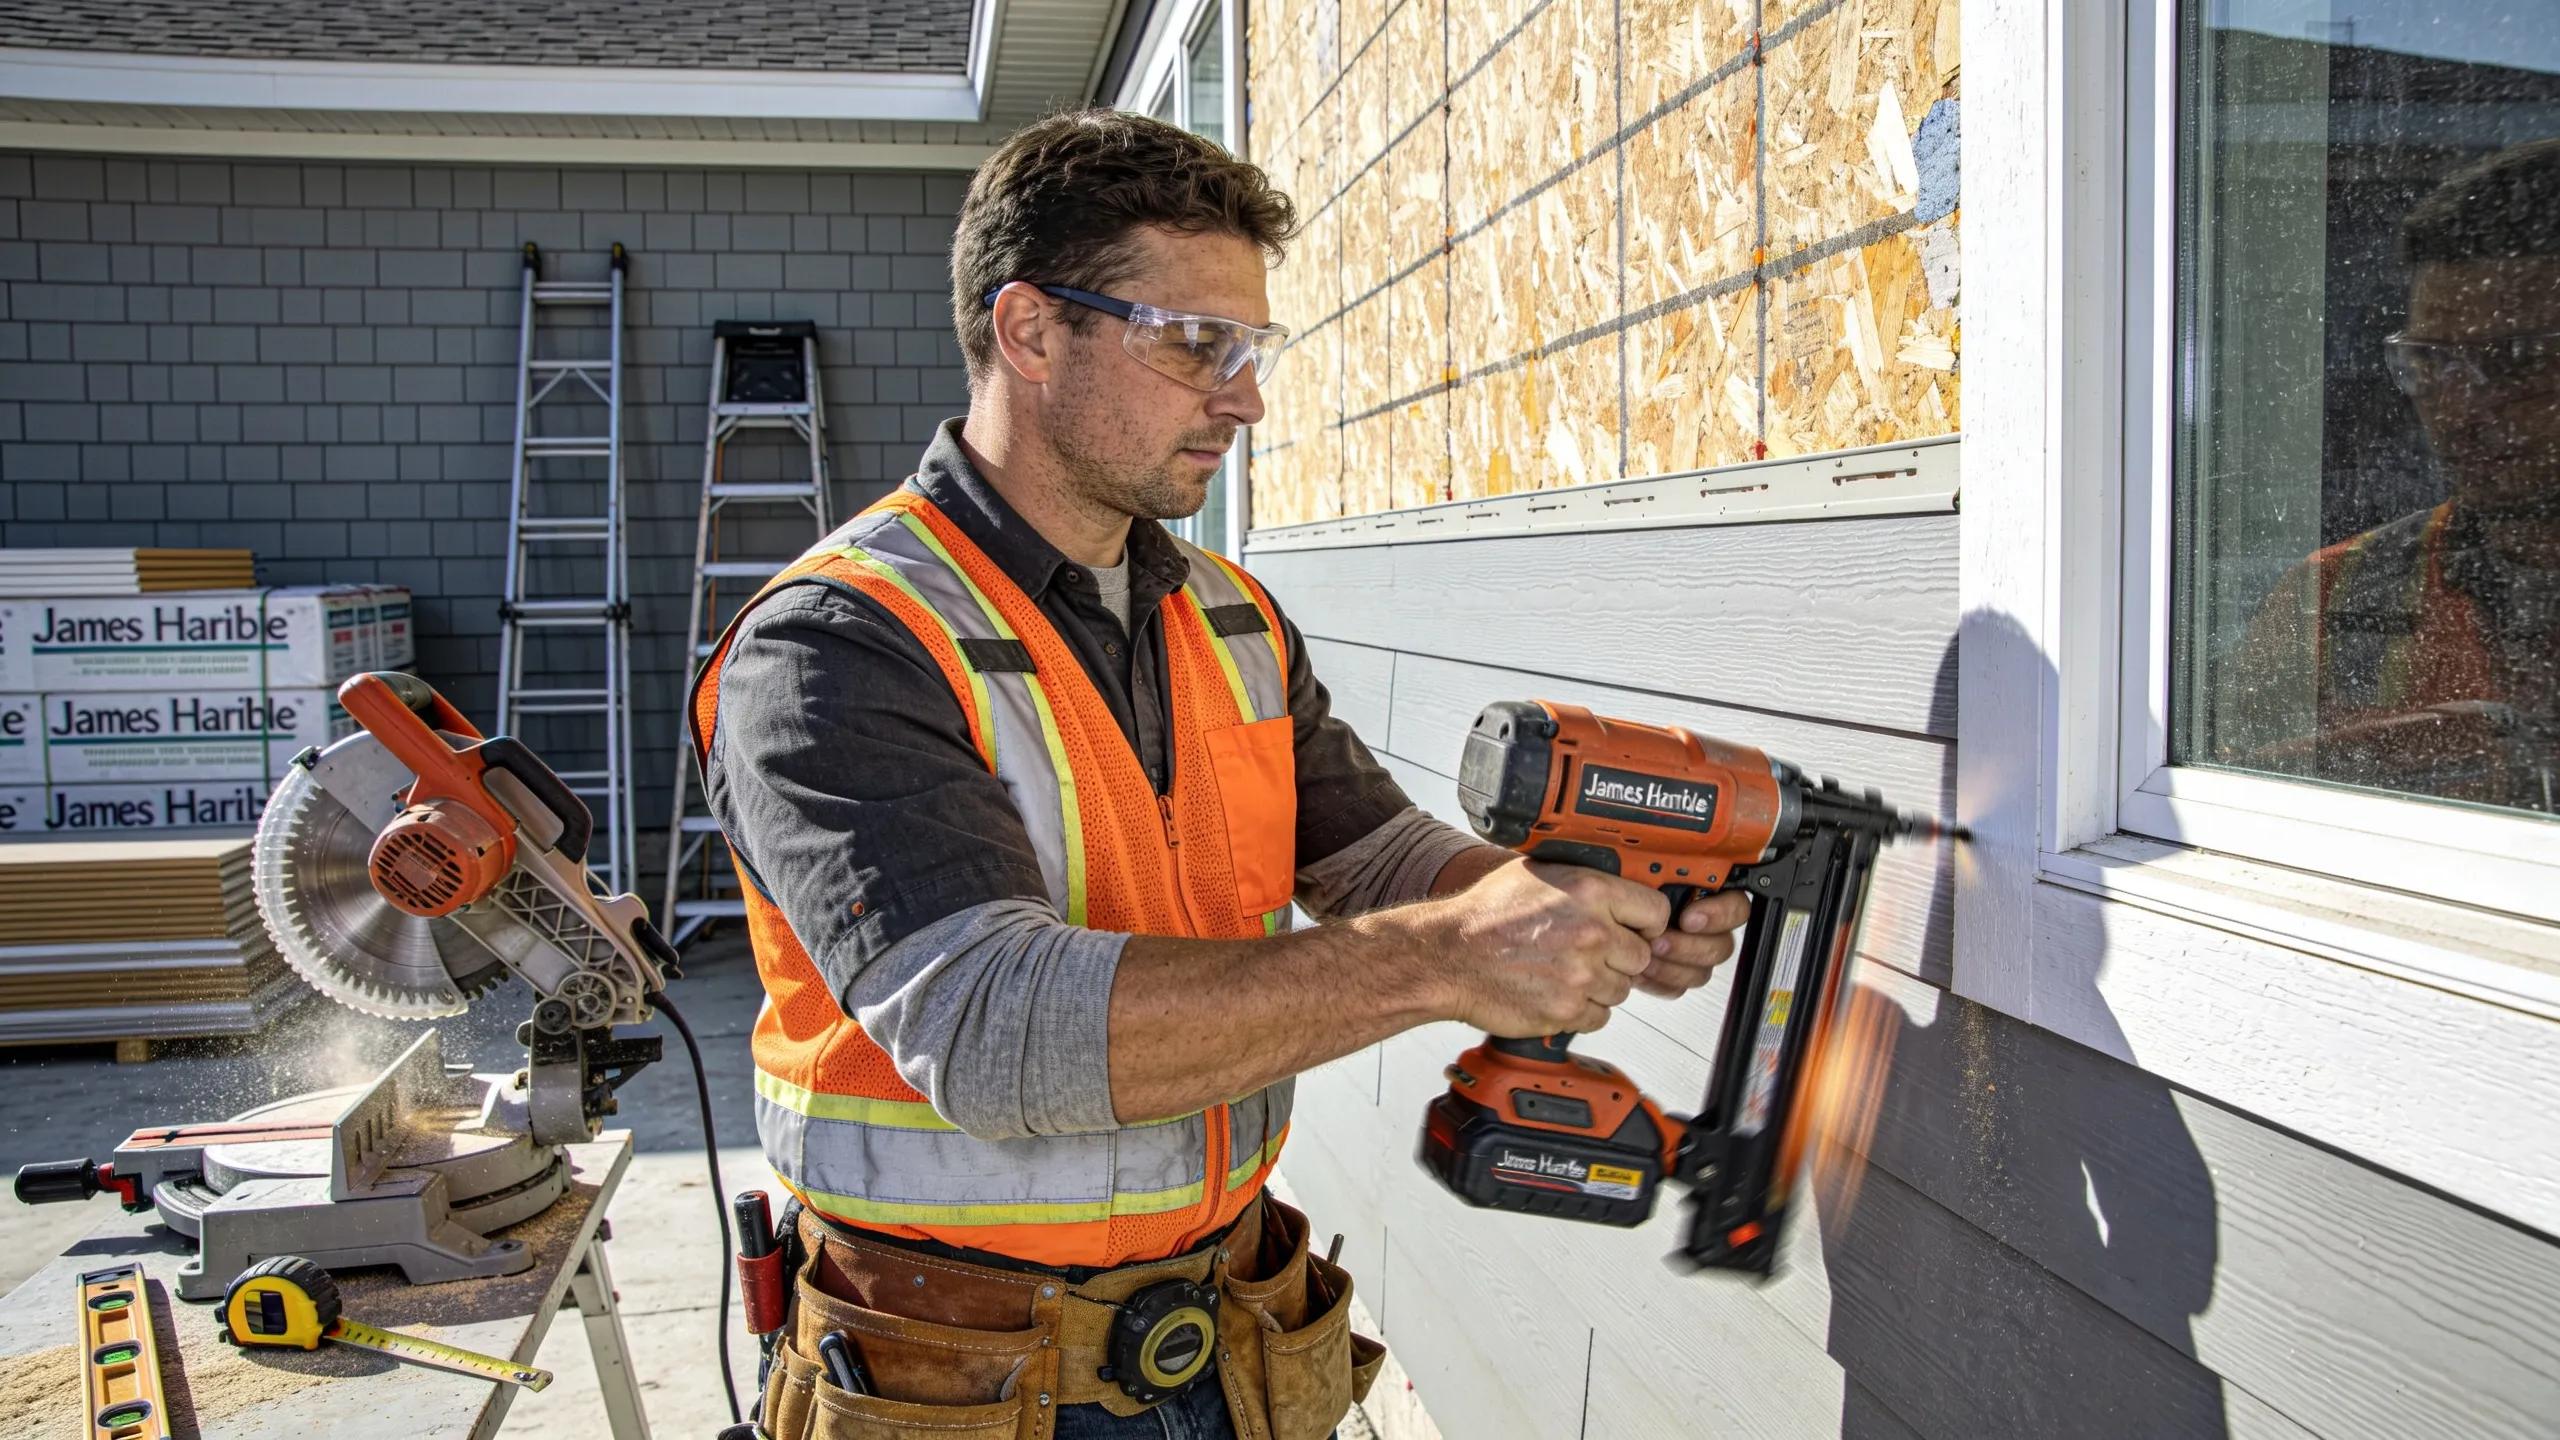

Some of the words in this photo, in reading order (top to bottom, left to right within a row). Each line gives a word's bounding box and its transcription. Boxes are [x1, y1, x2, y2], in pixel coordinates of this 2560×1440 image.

[32, 607, 143, 642] James
[154, 606, 288, 641] Haribe
[51, 700, 160, 735] James
[169, 697, 297, 731] Harible
[1584, 773, 1643, 804] James
[45, 792, 154, 829] James
[165, 786, 267, 824] Harib
